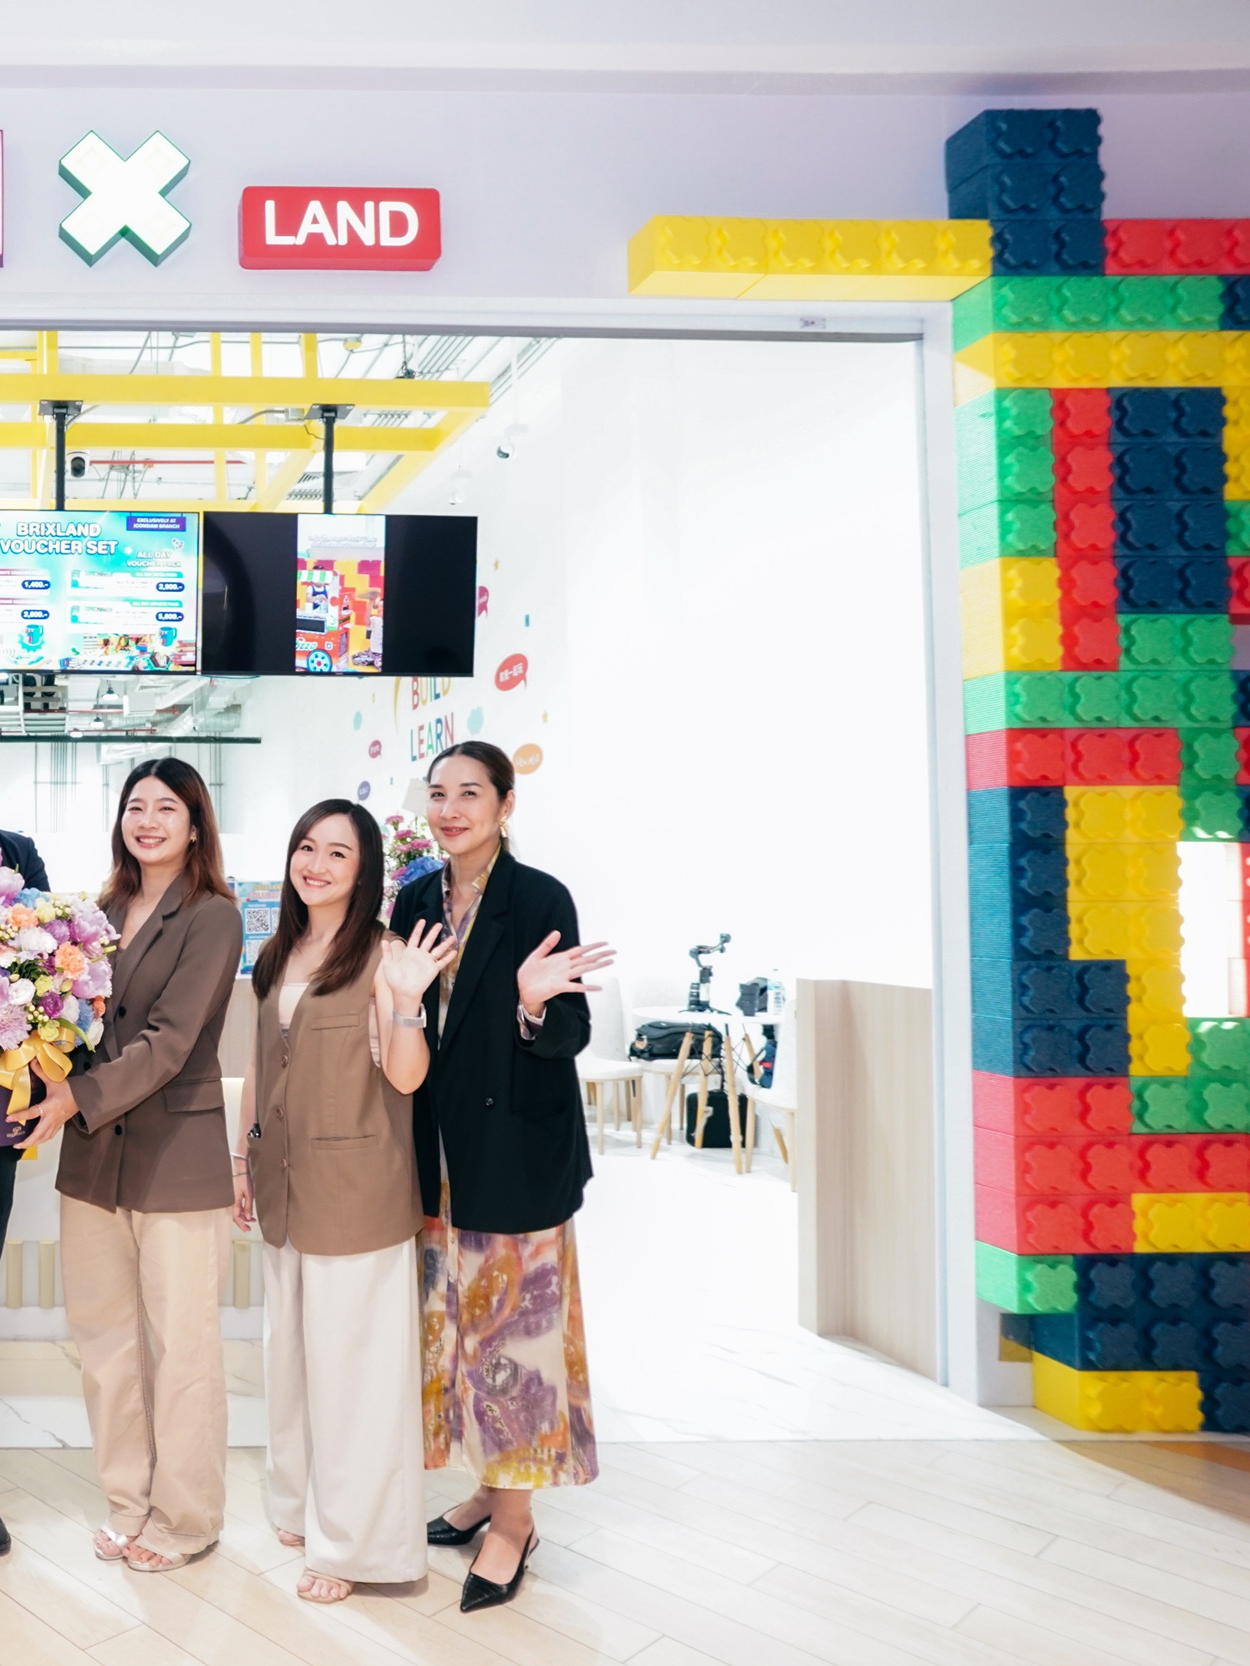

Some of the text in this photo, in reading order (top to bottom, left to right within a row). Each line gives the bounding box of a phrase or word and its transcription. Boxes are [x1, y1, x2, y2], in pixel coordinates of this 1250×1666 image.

[263, 199, 420, 248] LAND
[17, 522, 102, 538] BRIXLAND
[0, 539, 119, 555] VOUCHER SET
[137, 551, 172, 559] ALL DAY
[411, 677, 450, 711] BUILD
[410, 712, 455, 762] LEARN
